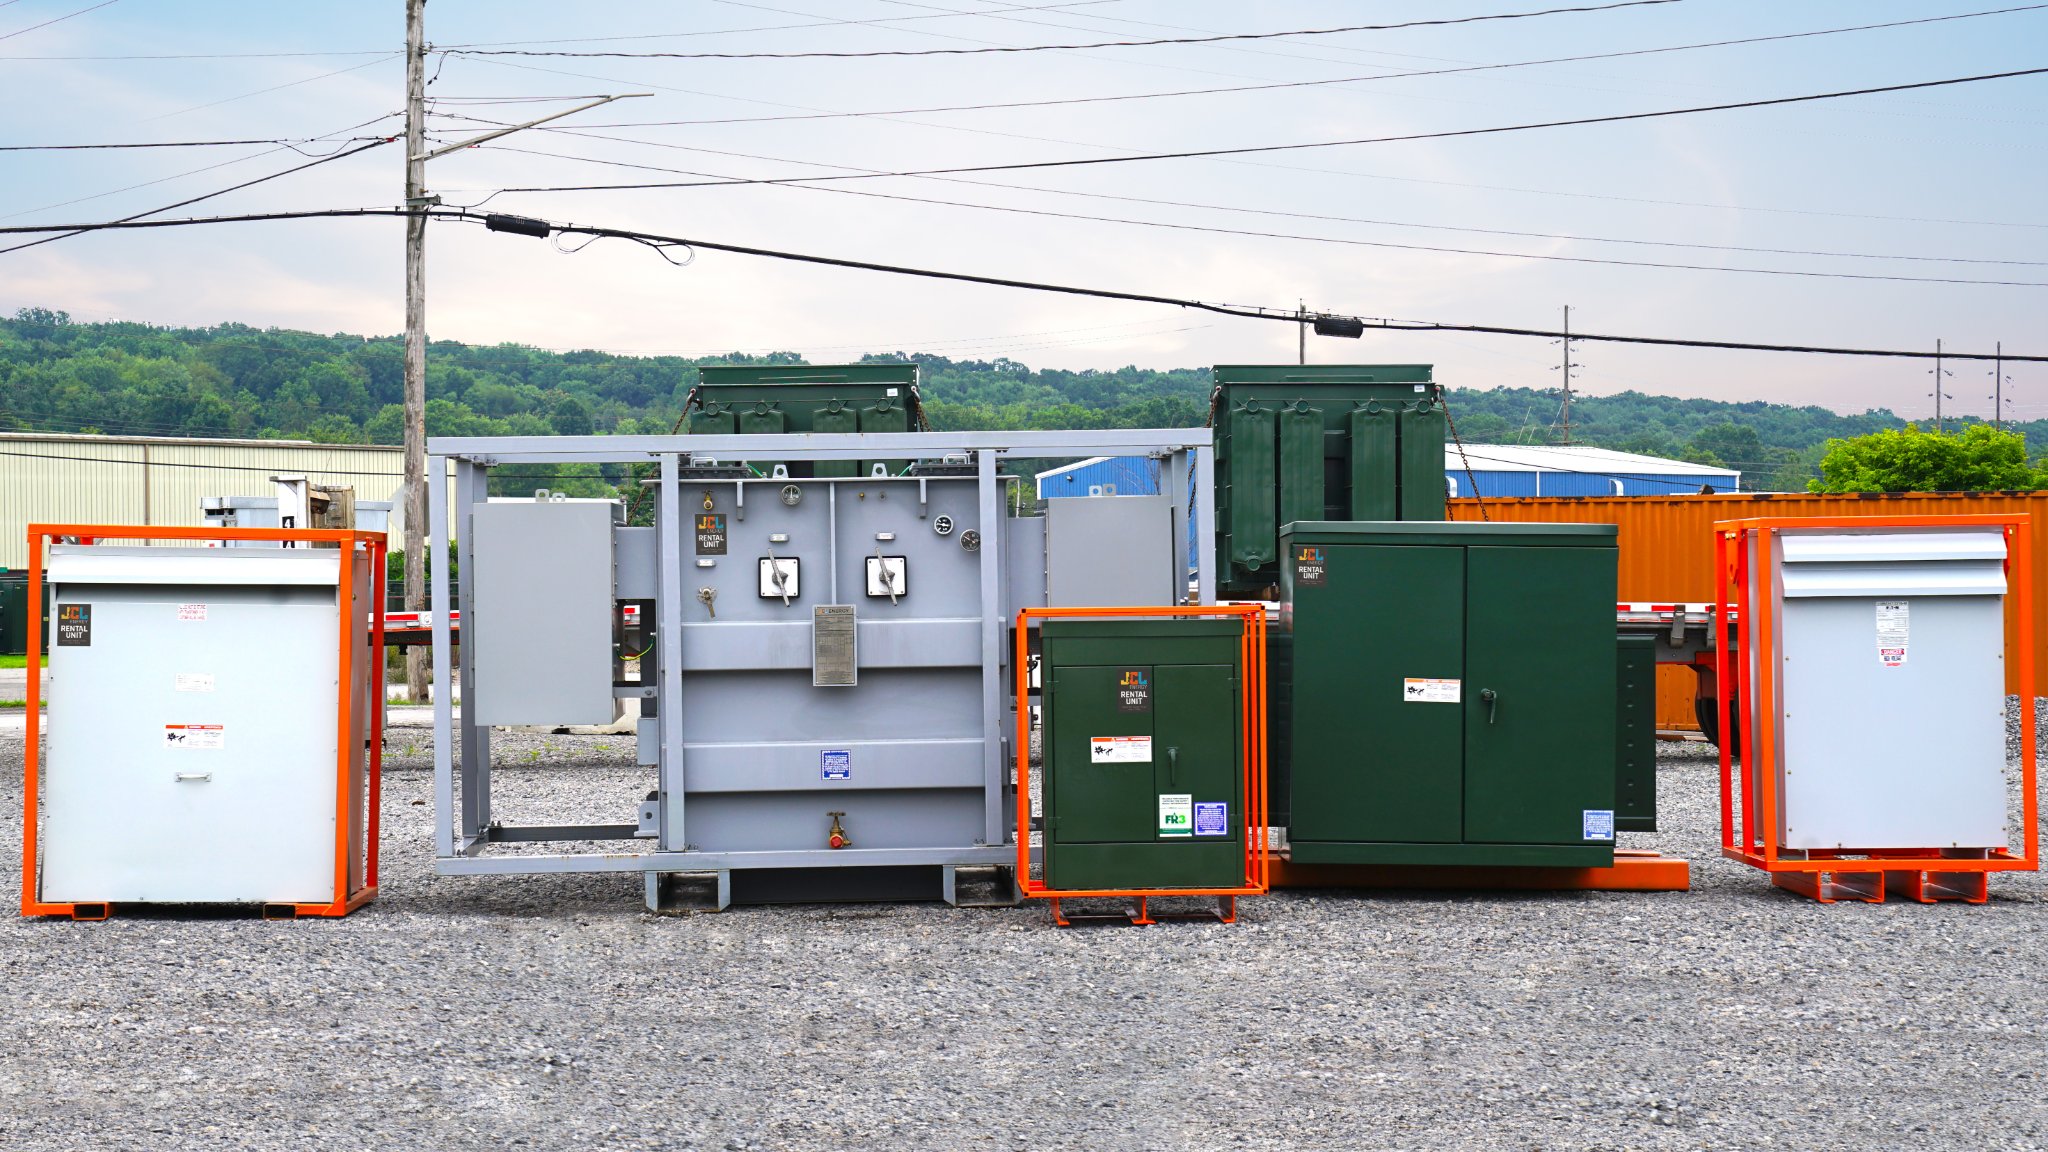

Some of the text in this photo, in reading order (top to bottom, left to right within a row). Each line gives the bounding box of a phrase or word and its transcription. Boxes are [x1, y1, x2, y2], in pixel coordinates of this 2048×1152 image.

[284, 518, 291, 529] 4
[698, 516, 724, 529] JCL
[1299, 548, 1324, 561] JCL
[61, 606, 88, 620] JCL
[65, 631, 83, 639] UNIT
[1120, 671, 1148, 685] JCL
[1120, 690, 1148, 698] RENTAL
[1165, 814, 1186, 824] FR3
